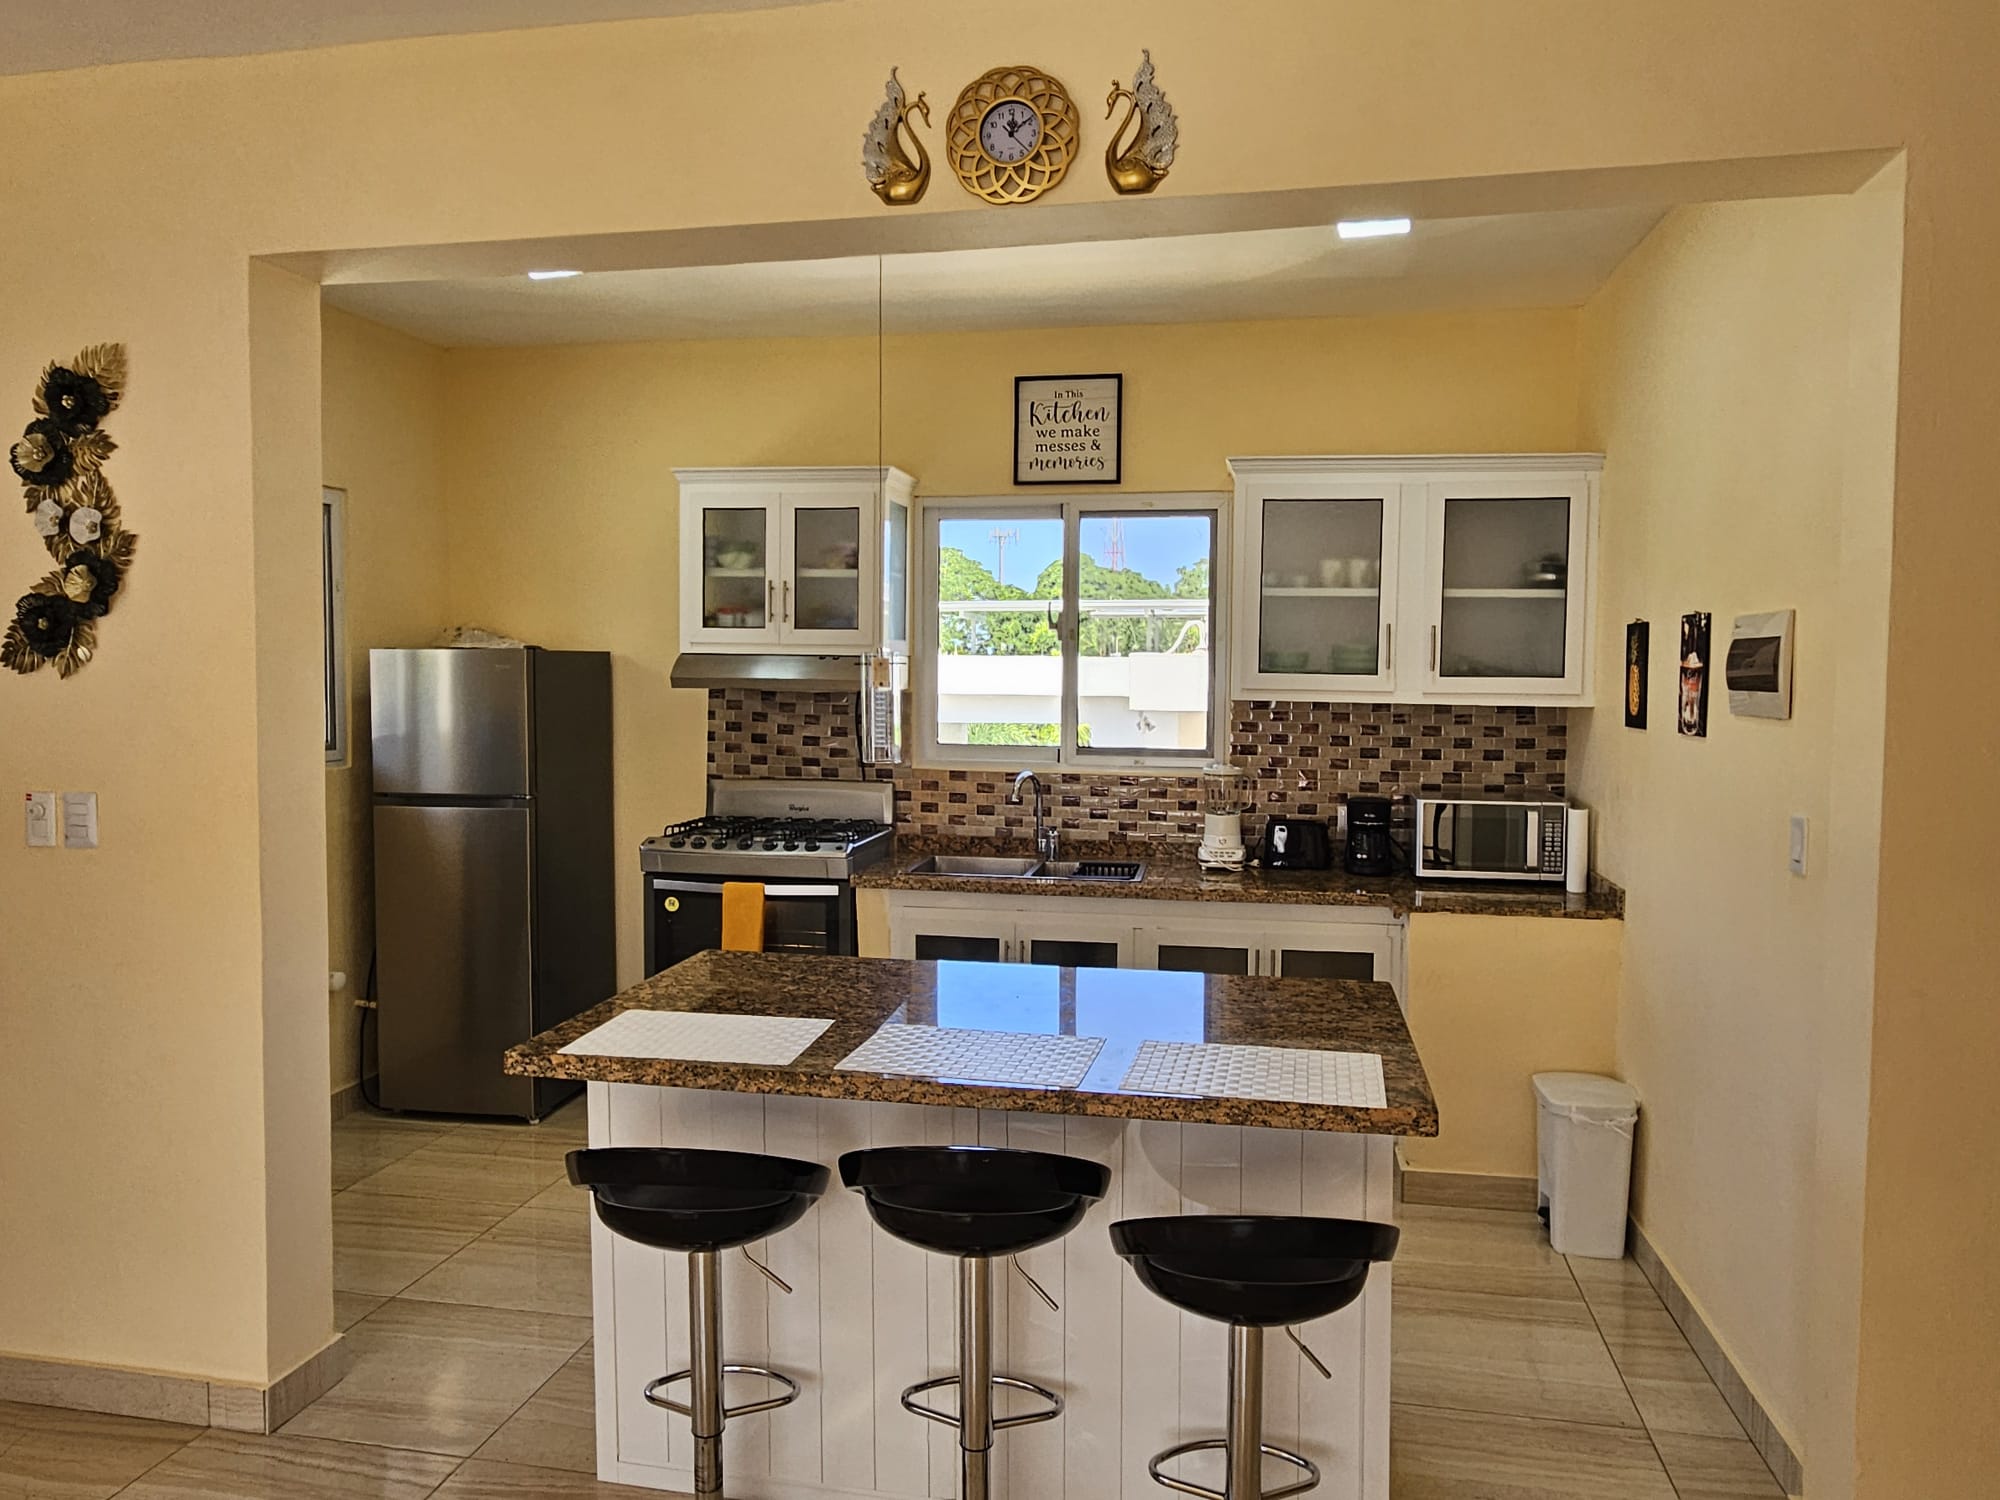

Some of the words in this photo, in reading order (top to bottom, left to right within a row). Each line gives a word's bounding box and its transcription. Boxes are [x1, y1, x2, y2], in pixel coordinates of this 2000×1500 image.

[1031, 129, 1036, 137] 3
[990, 143, 995, 151] 8
[1019, 149, 1024, 157] 5
[1054, 390, 1063, 399] In
[1065, 389, 1084, 399] This
[1029, 400, 1110, 427] Kitchen
[1035, 429, 1057, 438] we
[1061, 424, 1100, 438] make
[1035, 441, 1086, 452] messes
[1090, 438, 1101, 451] &
[1029, 456, 1105, 471] memories
